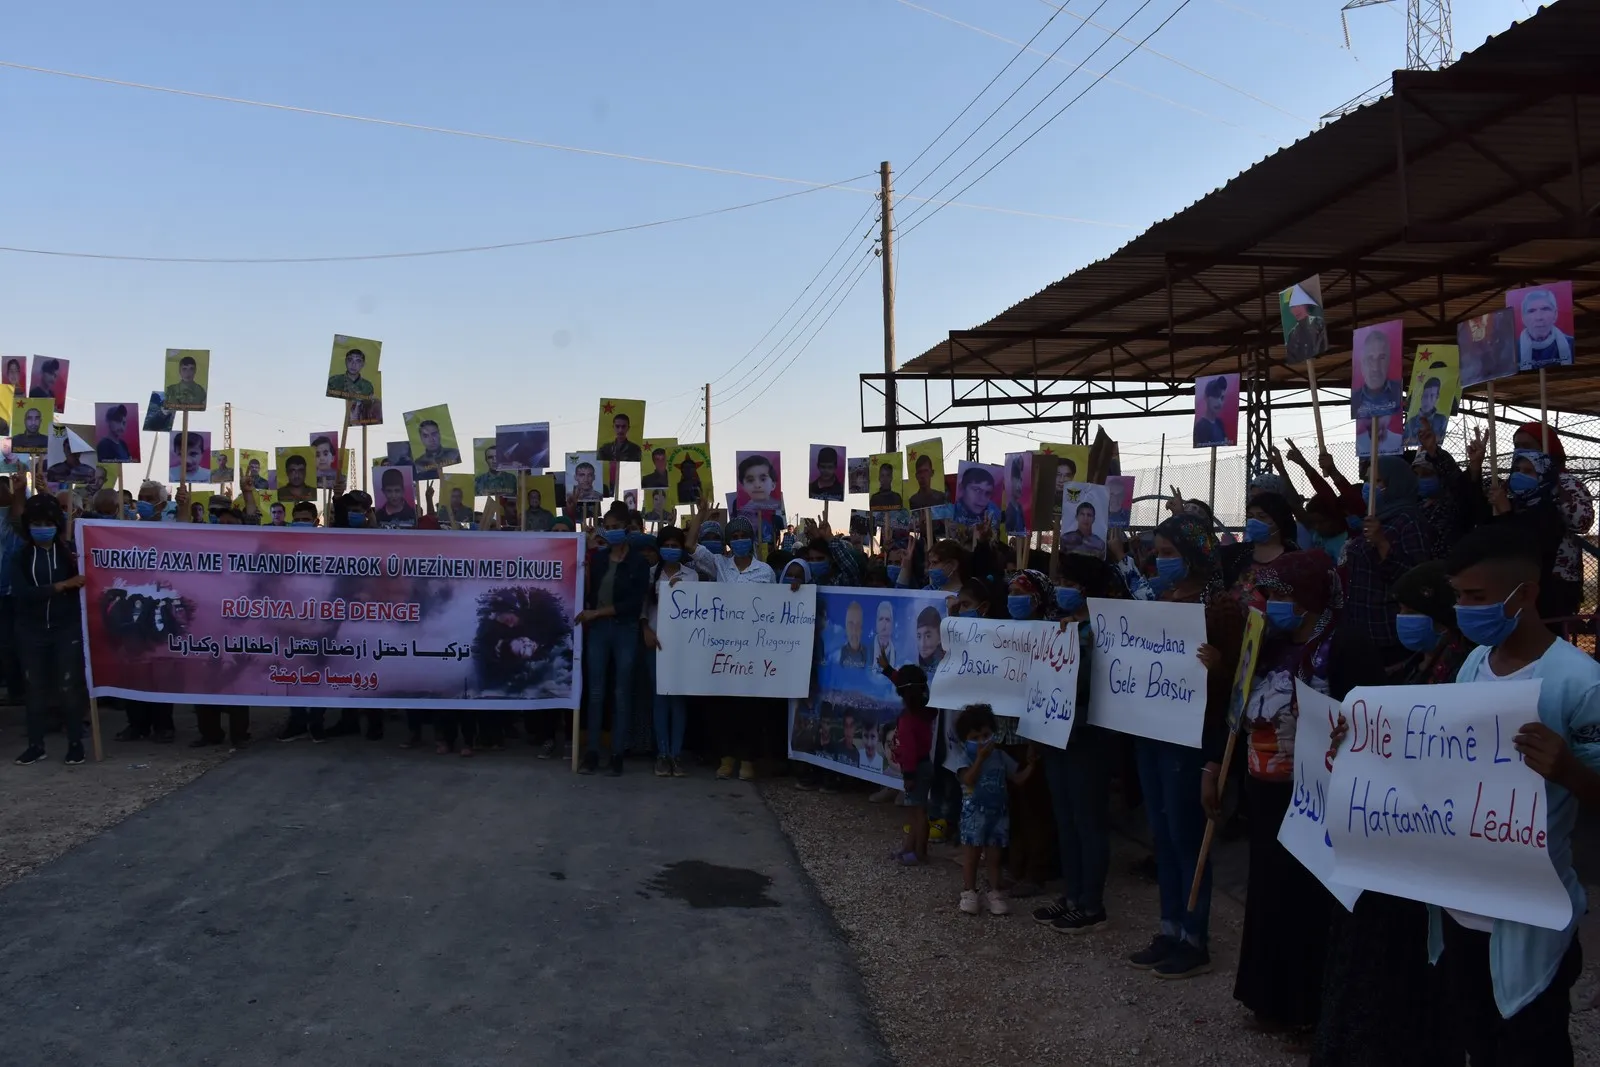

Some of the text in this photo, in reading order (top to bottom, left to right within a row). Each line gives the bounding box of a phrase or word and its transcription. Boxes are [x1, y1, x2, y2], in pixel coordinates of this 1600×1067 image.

[92, 546, 156, 569] TURKİYÊ
[159, 551, 193, 571] AXA
[197, 552, 222, 572] ME
[324, 556, 381, 577] ZAROK
[387, 554, 399, 577] Û
[403, 555, 475, 578] MEZİNEN
[478, 558, 501, 579] ME
[506, 556, 562, 580] DİKUJE
[221, 596, 420, 622] RÛSİYA JÎ BÊ DENGE
[966, 622, 988, 644] Der
[1120, 616, 1186, 654] Berxwedana
[168, 634, 220, 659] وكبارنا
[224, 636, 279, 656] أطفالنا
[285, 637, 319, 658] تقتل
[323, 638, 367, 659] أرضنا
[373, 639, 408, 660] تحتل
[269, 665, 379, 690] وروسيا صامتة
[763, 659, 777, 677] Ye
[1109, 658, 1196, 703] Gelê Başûr
[1349, 699, 1392, 759] Dilê
[1404, 704, 1477, 762] Efrînê
[1348, 776, 1547, 848] Haftanînê Lêdide
